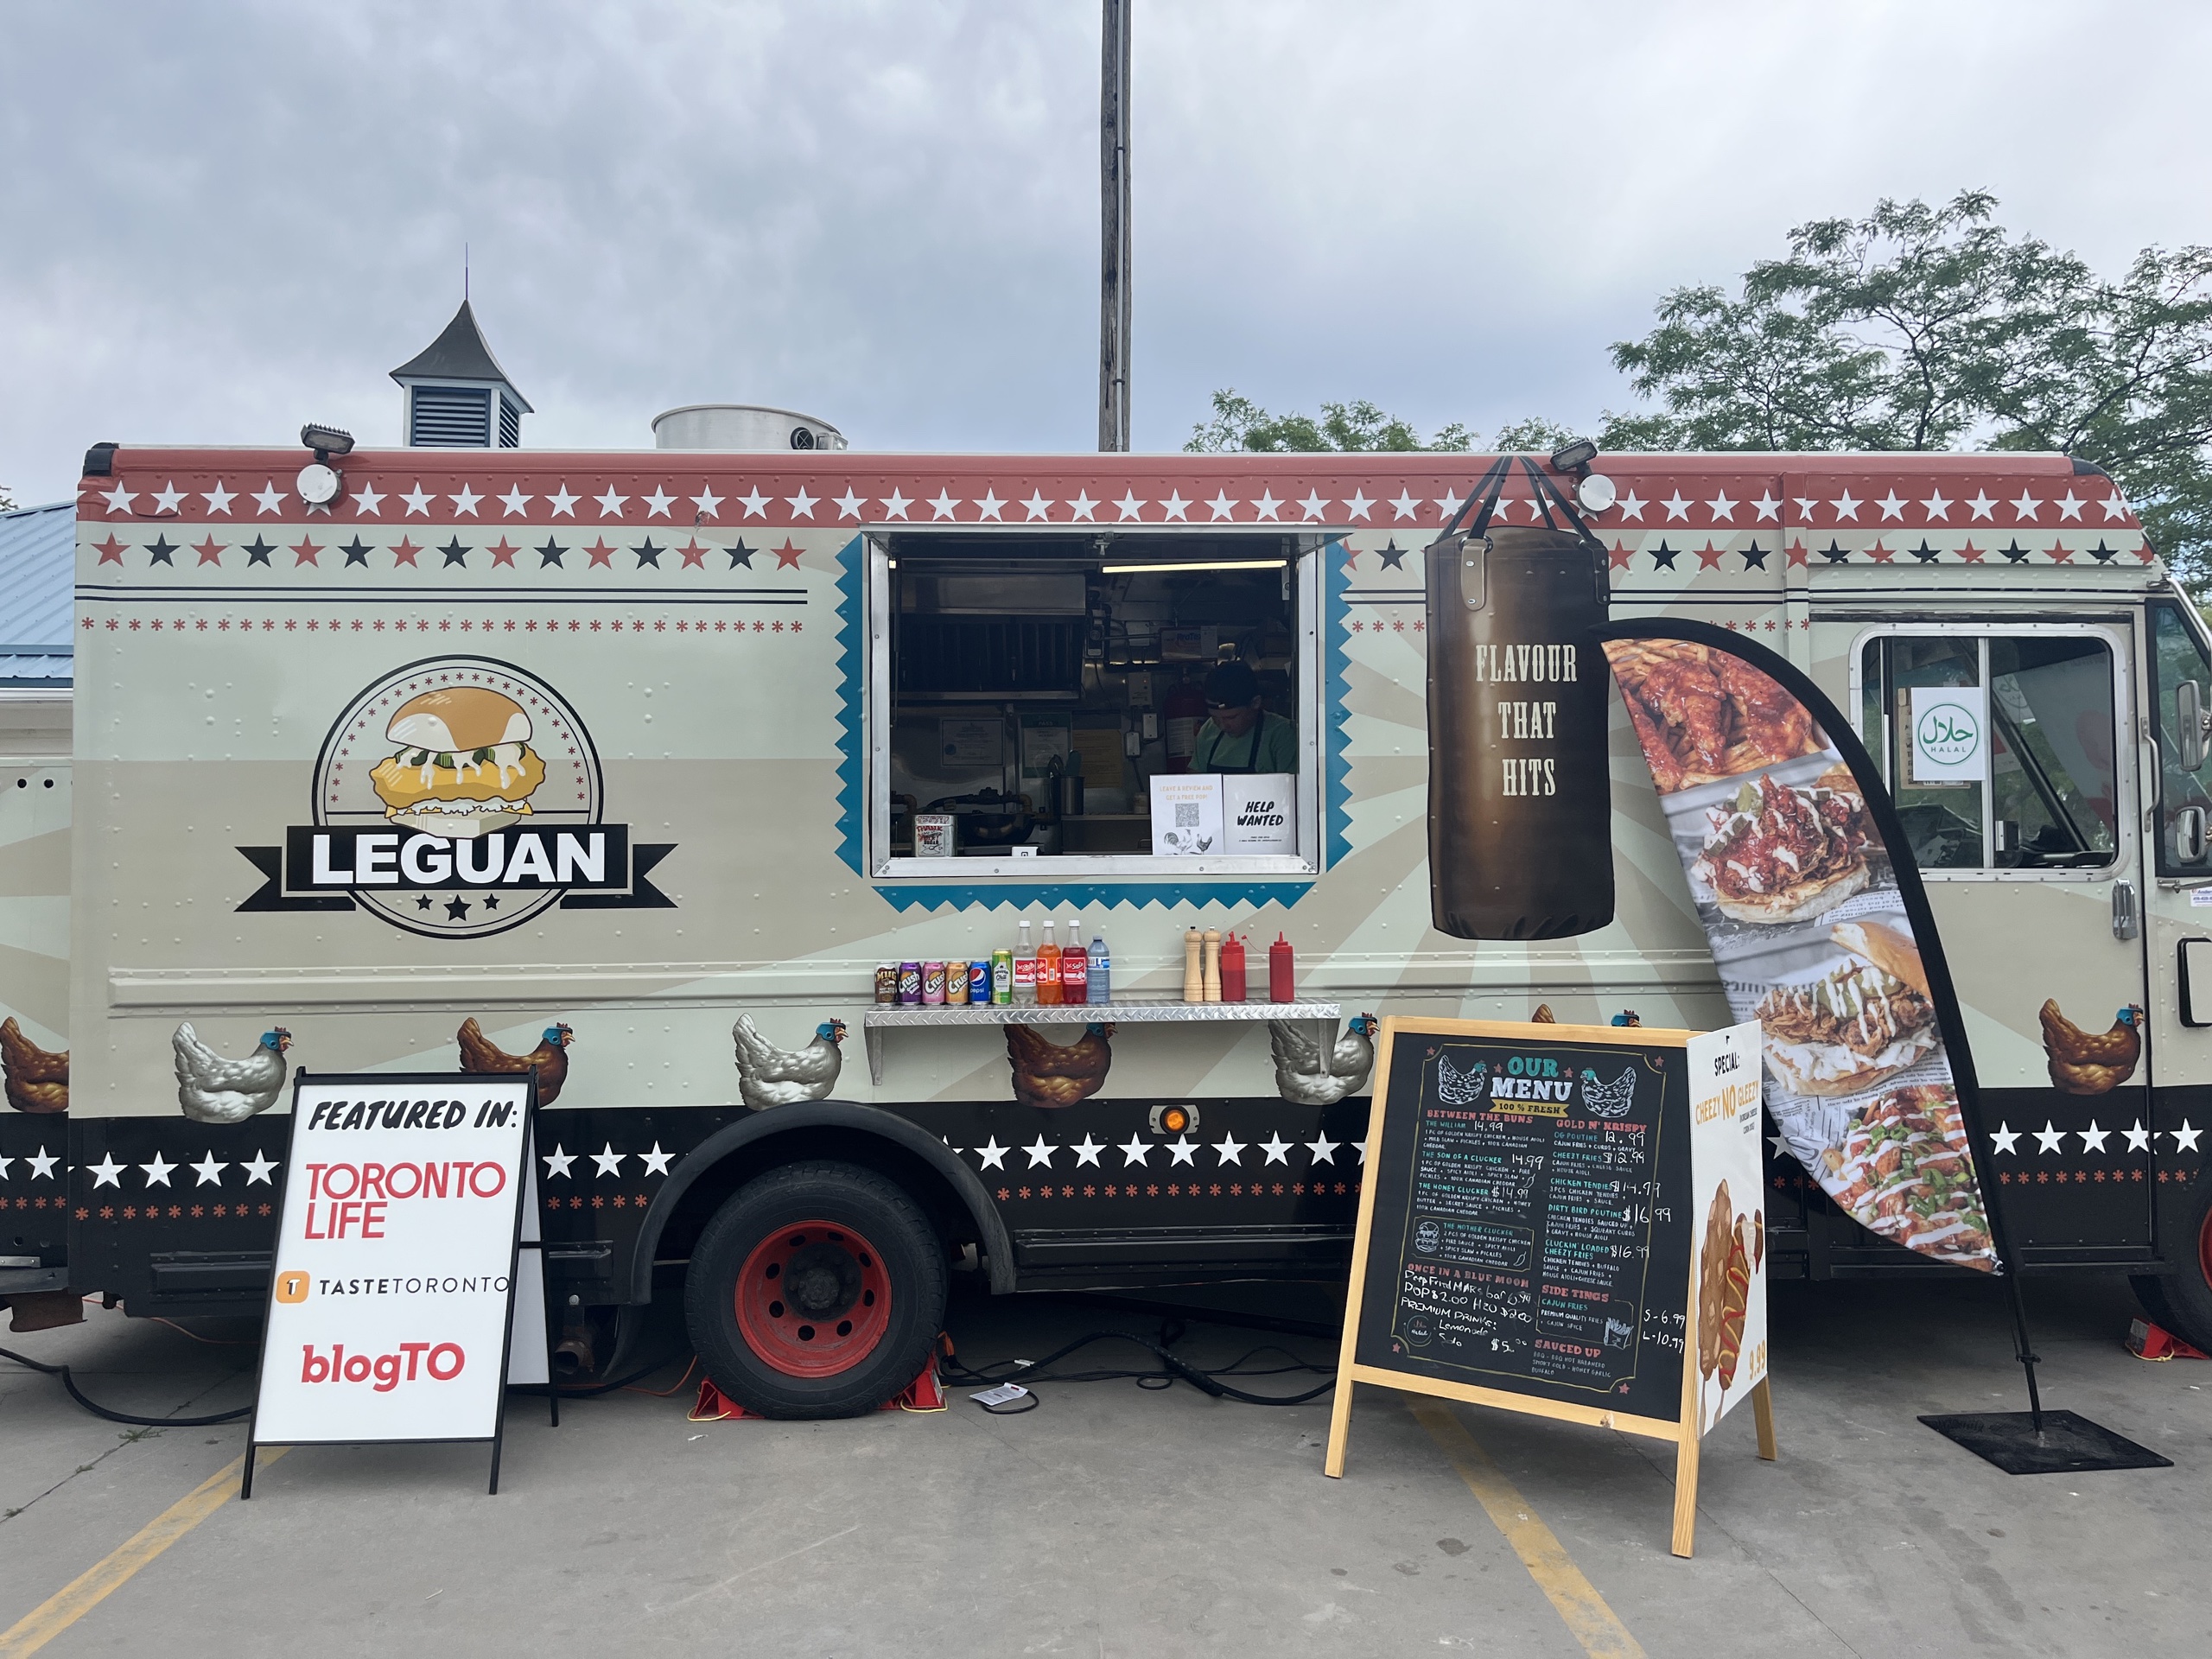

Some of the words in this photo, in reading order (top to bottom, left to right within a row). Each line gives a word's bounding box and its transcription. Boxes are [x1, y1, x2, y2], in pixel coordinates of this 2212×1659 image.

[1476, 645, 1578, 682] FLAVOUR
[1497, 702, 1556, 739] THAT
[1923, 715, 1974, 744] حلال
[1502, 759, 1556, 796] HITS
[1245, 801, 1274, 813] HELP
[1237, 815, 1284, 827] WANTED
[312, 832, 605, 885] LEGUAN
[876, 970, 897, 982] MUG
[899, 971, 920, 994] Crush
[1507, 1056, 1559, 1077] OUR
[1714, 1052, 1740, 1077] SPECIAL:
[1490, 1077, 1573, 1101] MENU
[1695, 1096, 1721, 1125] CHEEZY
[1722, 1084, 1736, 1121] NO
[1738, 1080, 1759, 1107] GLEEZY
[308, 1100, 466, 1130] FEATURED
[474, 1100, 518, 1128] IN:
[1427, 1109, 1477, 1121] BETWEEN
[1479, 1112, 1500, 1122] THE
[1503, 1114, 1534, 1123] BUNS
[1556, 1120, 1586, 1130] GOLD
[1603, 1122, 1647, 1133] KRISPY
[1567, 1134, 1599, 1142] POUTINE
[1471, 1154, 1503, 1164] CLUCKER
[1512, 1154, 1544, 1170] 14.99
[1553, 1151, 1580, 1160] CHEEZY
[1582, 1154, 1602, 1163] FRIES
[305, 1161, 506, 1200] TORONTO
[1433, 1184, 1455, 1192] HONEY
[1458, 1185, 1489, 1195] CLUCKER
[1550, 1177, 1582, 1187] CHICKEN
[1583, 1180, 1612, 1191] TENDIES
[304, 1201, 388, 1240] LIFE
[1548, 1204, 1568, 1213] DIRTY
[1571, 1206, 1588, 1215] BIRD
[1590, 1208, 1623, 1218] POUTINE
[1548, 1213, 1571, 1222] CHICKEN
[1573, 1217, 1594, 1225] TENDIES
[1457, 1224, 1483, 1232] MOTHER
[1484, 1227, 1514, 1236] CLUCKER
[1480, 1249, 1502, 1258] PICKLES
[1545, 1239, 1580, 1249] CLUCKIN'
[1581, 1243, 1609, 1254] LOADED
[1545, 1247, 1572, 1258] CHEEZY
[1574, 1250, 1593, 1260] FRIES
[1543, 1255, 1567, 1264] CHICKEN
[1568, 1259, 1590, 1268] TENDIES
[1597, 1262, 1620, 1272] BUFFALO
[1405, 1270, 1427, 1286] Deep
[1486, 1285, 1506, 1300] bar
[1408, 1263, 1436, 1274] ONCE
[1439, 1267, 1450, 1277] IN
[1453, 1270, 1461, 1279] A
[1465, 1271, 1492, 1282] BLUE
[1495, 1275, 1529, 1288] MOON
[319, 1276, 510, 1295] TASTETORONTO
[1541, 1284, 1569, 1297] SIDE
[1571, 1289, 1610, 1303] TINGS
[1401, 1296, 1452, 1319] PREMIUM
[1541, 1298, 1566, 1308] CAJUN
[1567, 1301, 1588, 1312] FRIES
[1541, 1310, 1564, 1319] PREMIUM
[1566, 1313, 1587, 1322] QUALITY
[1588, 1317, 1604, 1325] FRIES
[1439, 1319, 1489, 1336] Lemonade
[1535, 1338, 1582, 1355] SAUCED
[1585, 1347, 1602, 1358] UP
[301, 1342, 466, 1393] blogTO
[1749, 1340, 1766, 1381] 9.99
